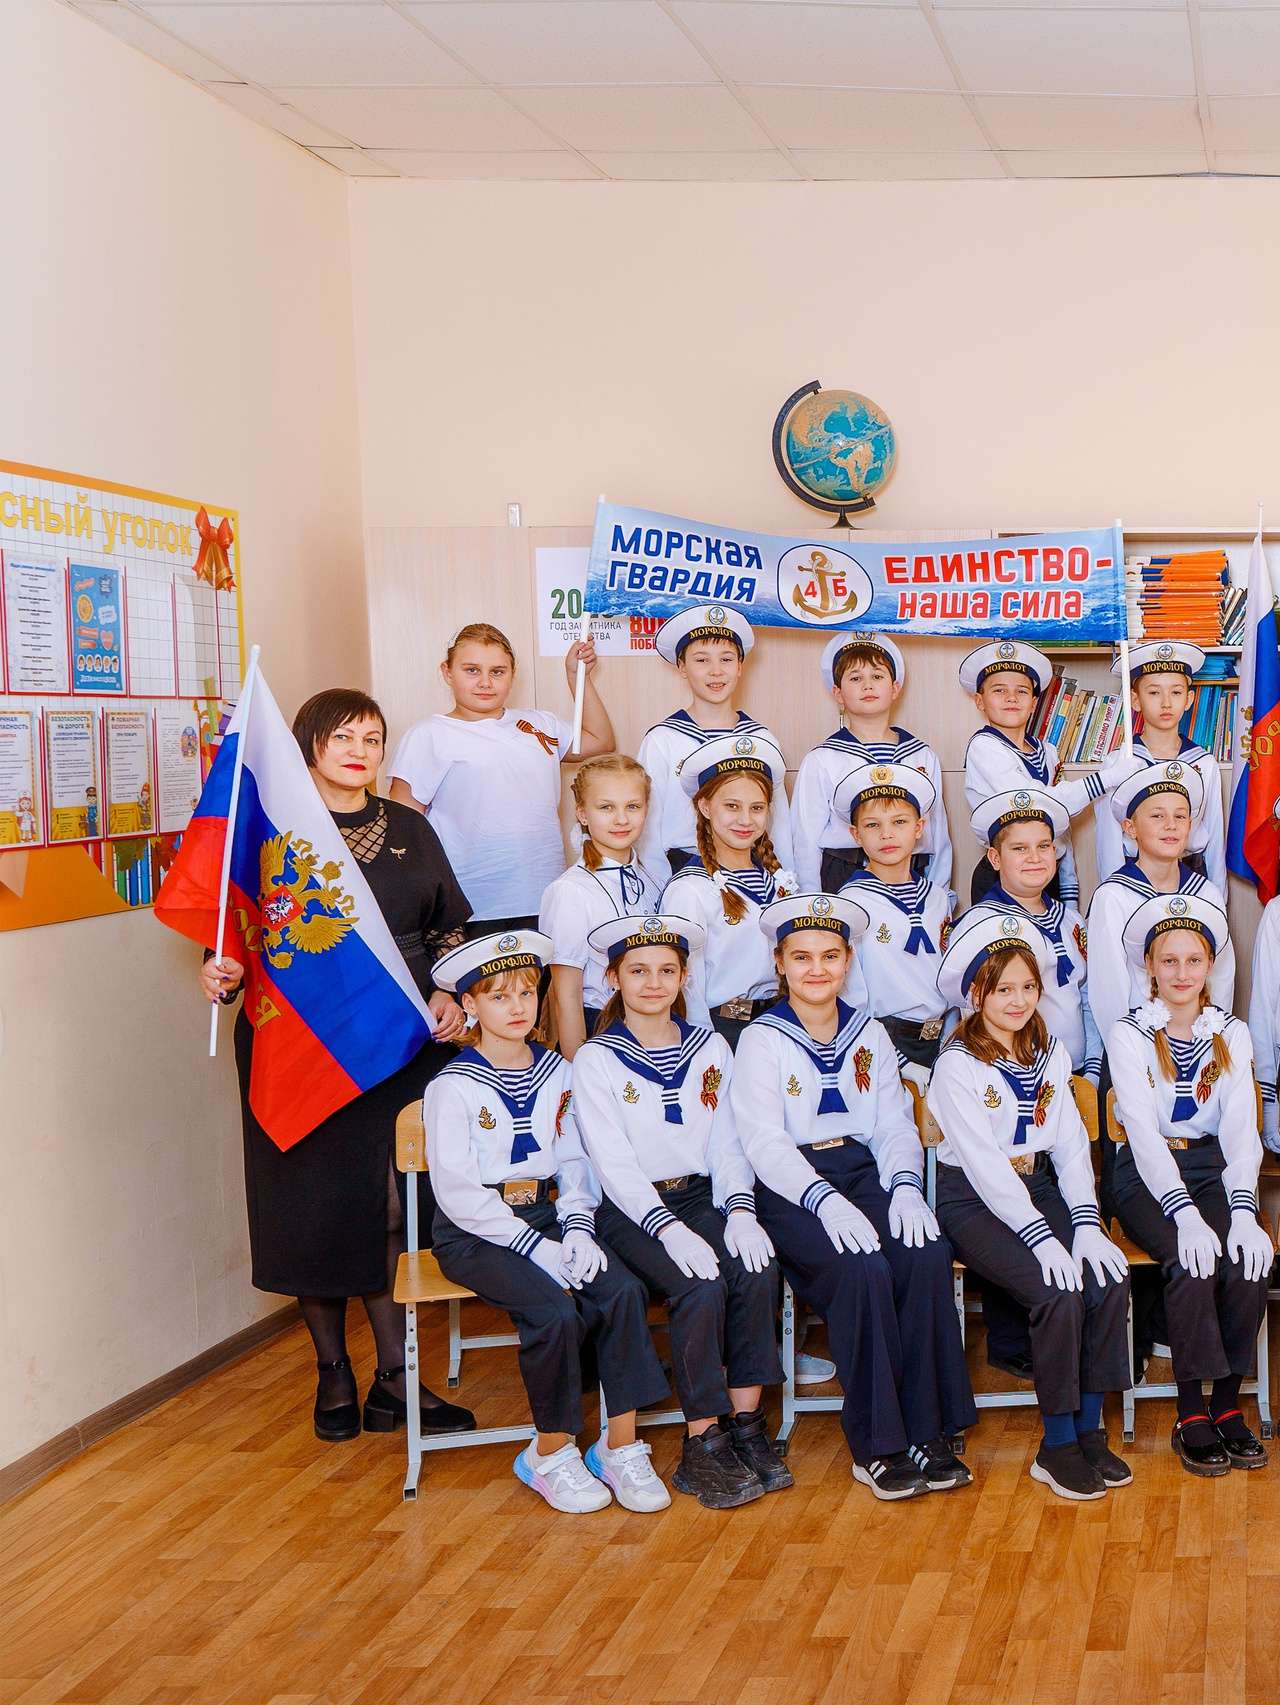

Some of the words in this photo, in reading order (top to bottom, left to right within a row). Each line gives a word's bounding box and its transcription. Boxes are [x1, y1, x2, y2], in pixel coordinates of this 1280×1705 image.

[102, 508, 193, 555] уголок
[804, 580, 817, 598] 4
[833, 578, 848, 597] Б
[550, 622, 568, 631] ГОД
[569, 621, 622, 630] ЗАИТНИКА
[689, 626, 734, 639] МОРФЛОТ
[563, 632, 611, 641] ОТЕСТВА
[984, 664, 1027, 675] МОРФЛОТ
[1142, 662, 1185, 673] МОРФЛОТ
[717, 760, 765, 772] МОРФЛОТ
[860, 787, 906, 800] МОРФЛОТ
[1000, 810, 1044, 824] МОРФЛОТ
[793, 917, 842, 931] МОРФЛОТ
[1154, 920, 1202, 934] МОРФЛОТ
[626, 933, 678, 947] МОРФЛОТ
[481, 954, 536, 976] МОРФЛОТ
